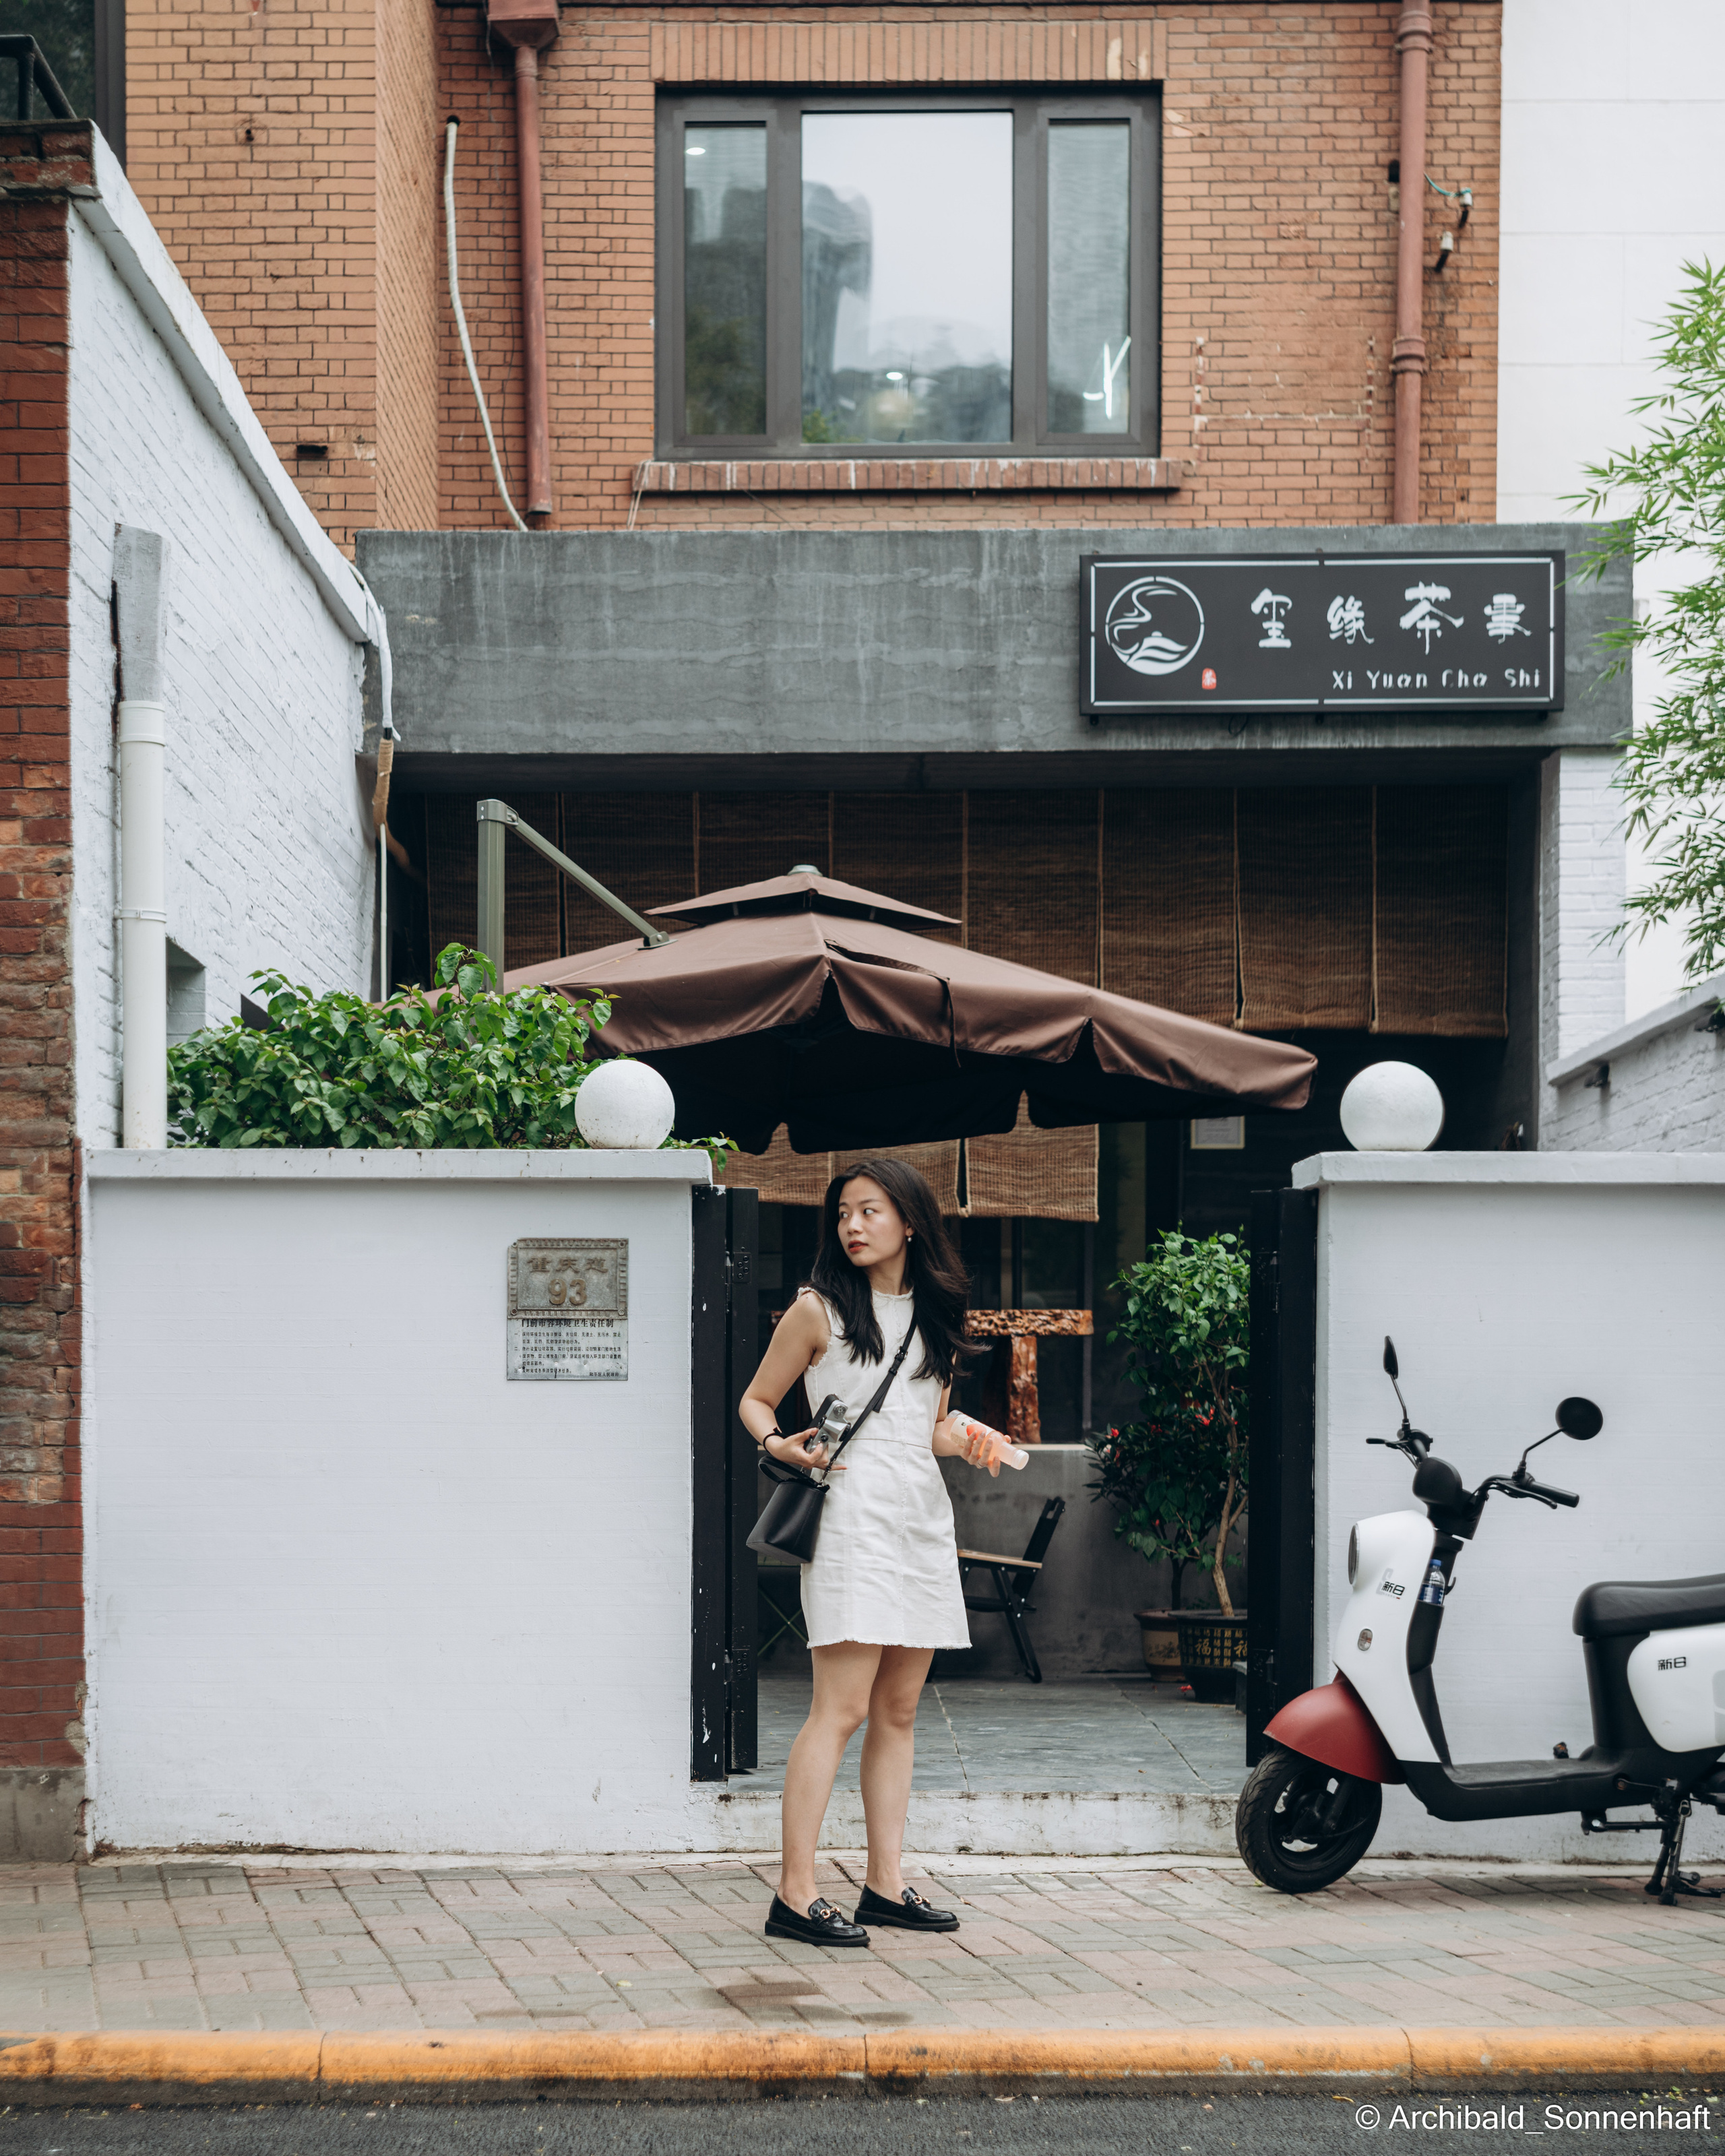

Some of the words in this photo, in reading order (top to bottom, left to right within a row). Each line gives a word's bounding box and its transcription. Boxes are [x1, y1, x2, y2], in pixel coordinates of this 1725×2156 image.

[1332, 670, 1352, 690] Xi
[1367, 670, 1427, 690] Yuan
[1504, 668, 1540, 688] Shi
[526, 1257, 608, 1273] 重庆道
[548, 1277, 588, 1306] 93
[521, 1319, 615, 1328] 门前市容环境卫生责任制
[1381, 1581, 1406, 1596] 新日
[1658, 1656, 1687, 1671] 新日
